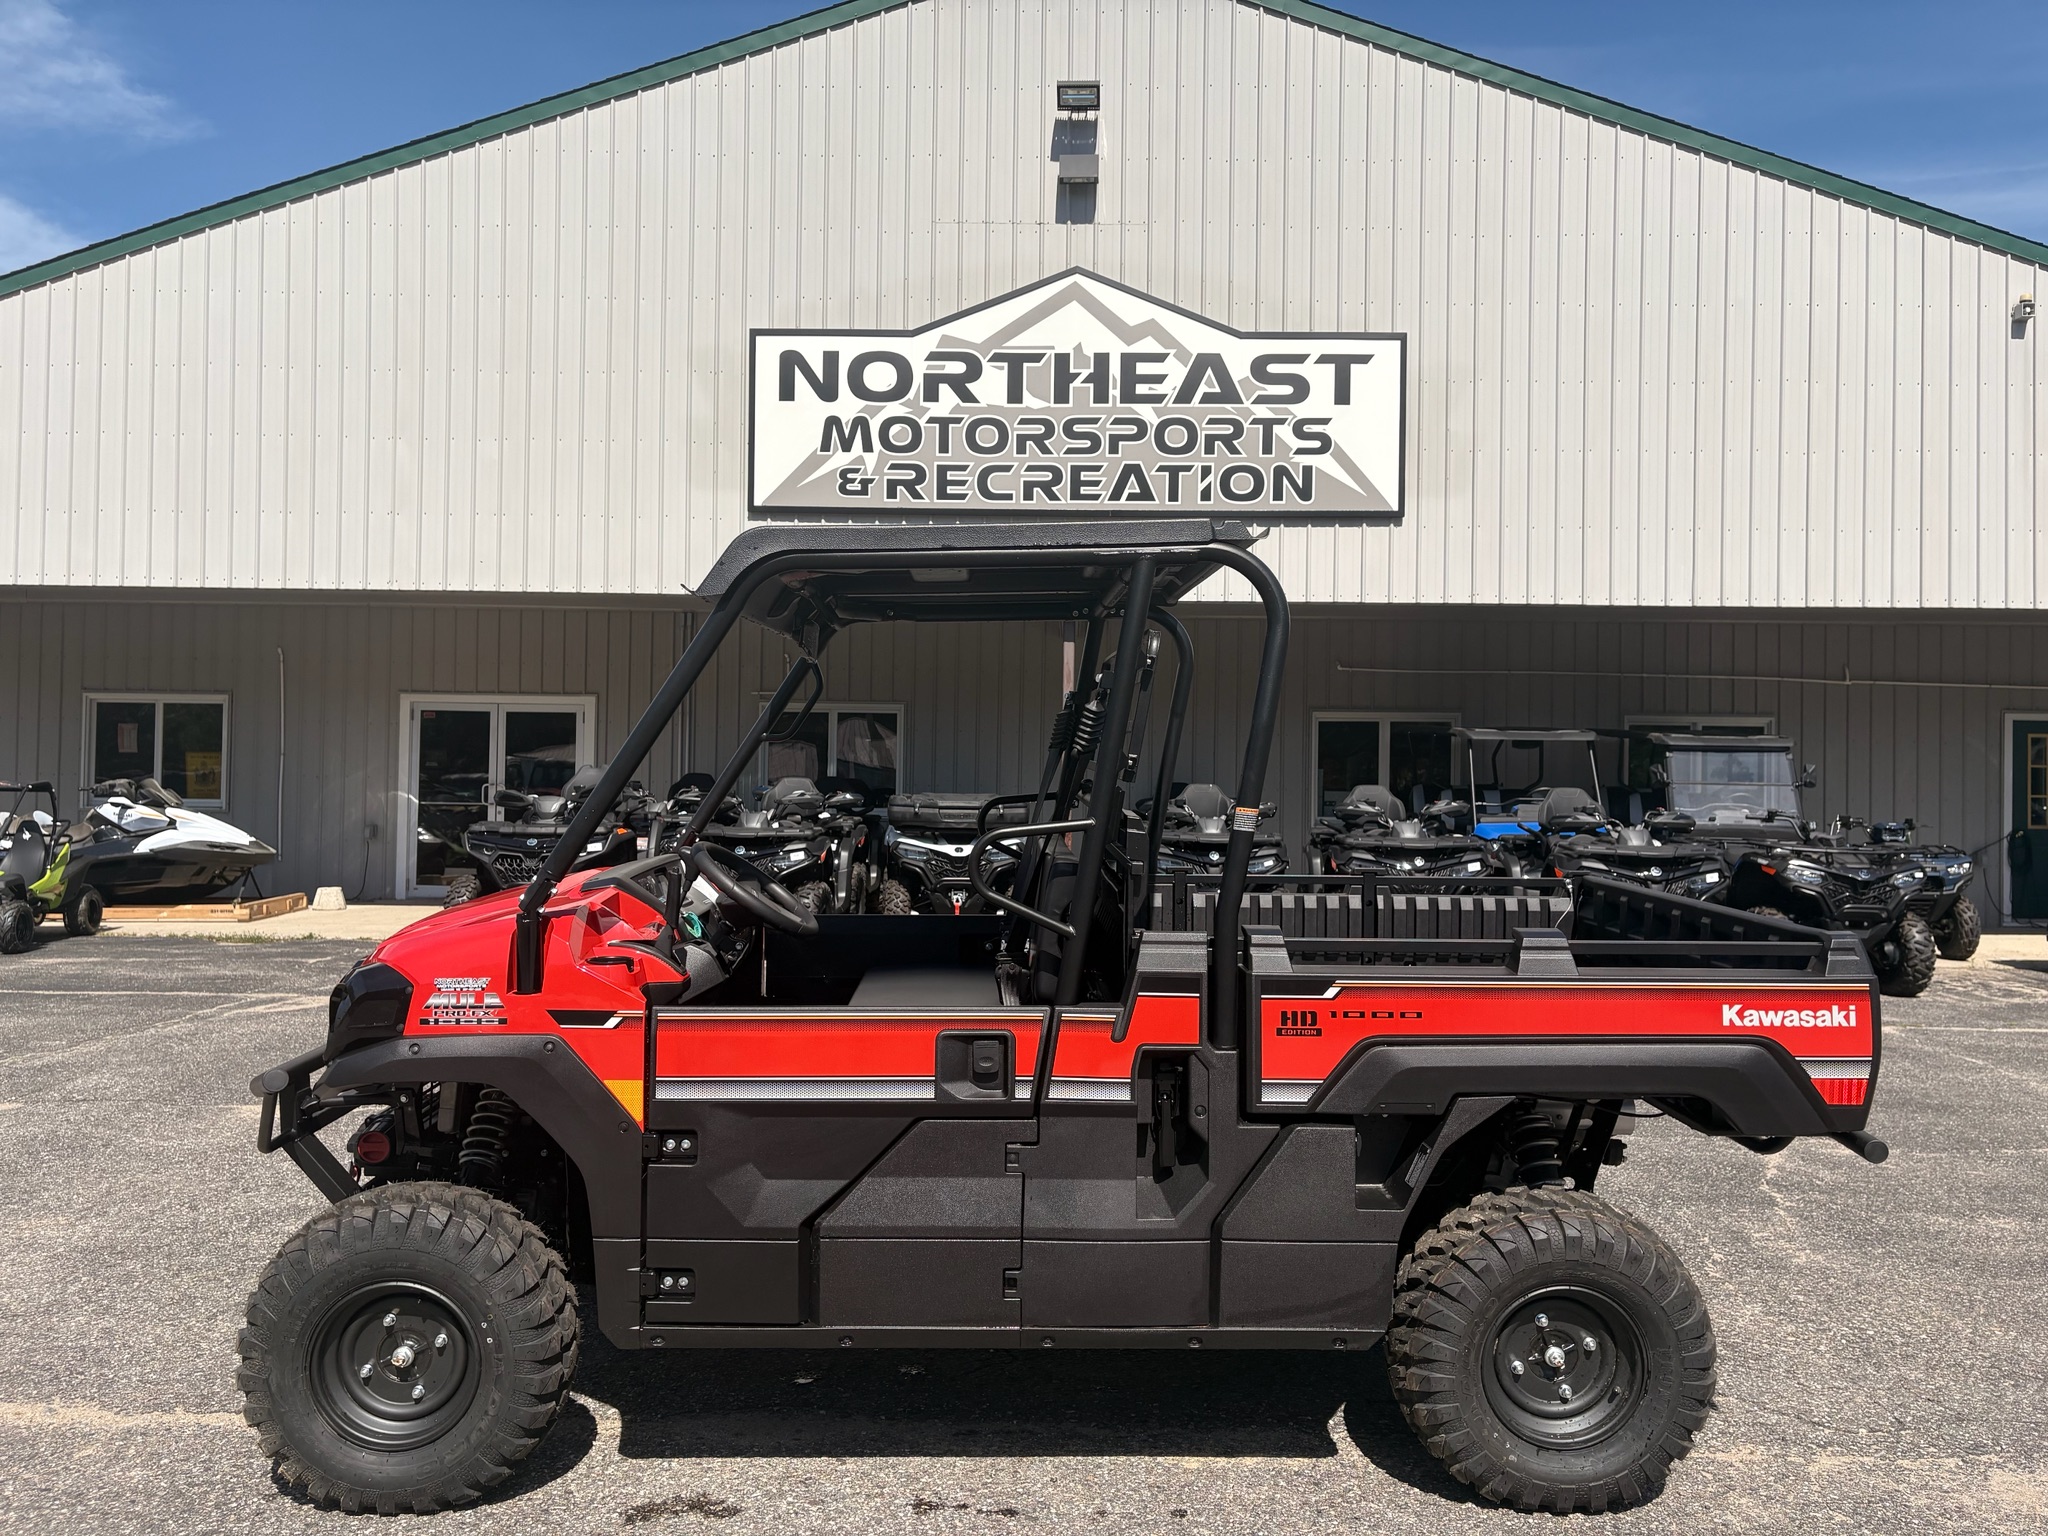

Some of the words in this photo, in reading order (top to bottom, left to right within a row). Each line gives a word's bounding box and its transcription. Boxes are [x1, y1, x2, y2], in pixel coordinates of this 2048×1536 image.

[778, 350, 1374, 406] NORTHEAST
[818, 415, 1333, 456] MOTORSPORTS
[422, 993, 505, 1009] MULE
[1280, 1010, 1318, 1027] HD
[1328, 1010, 1423, 1019] 1000
[1722, 1004, 1857, 1028] Kawasaki
